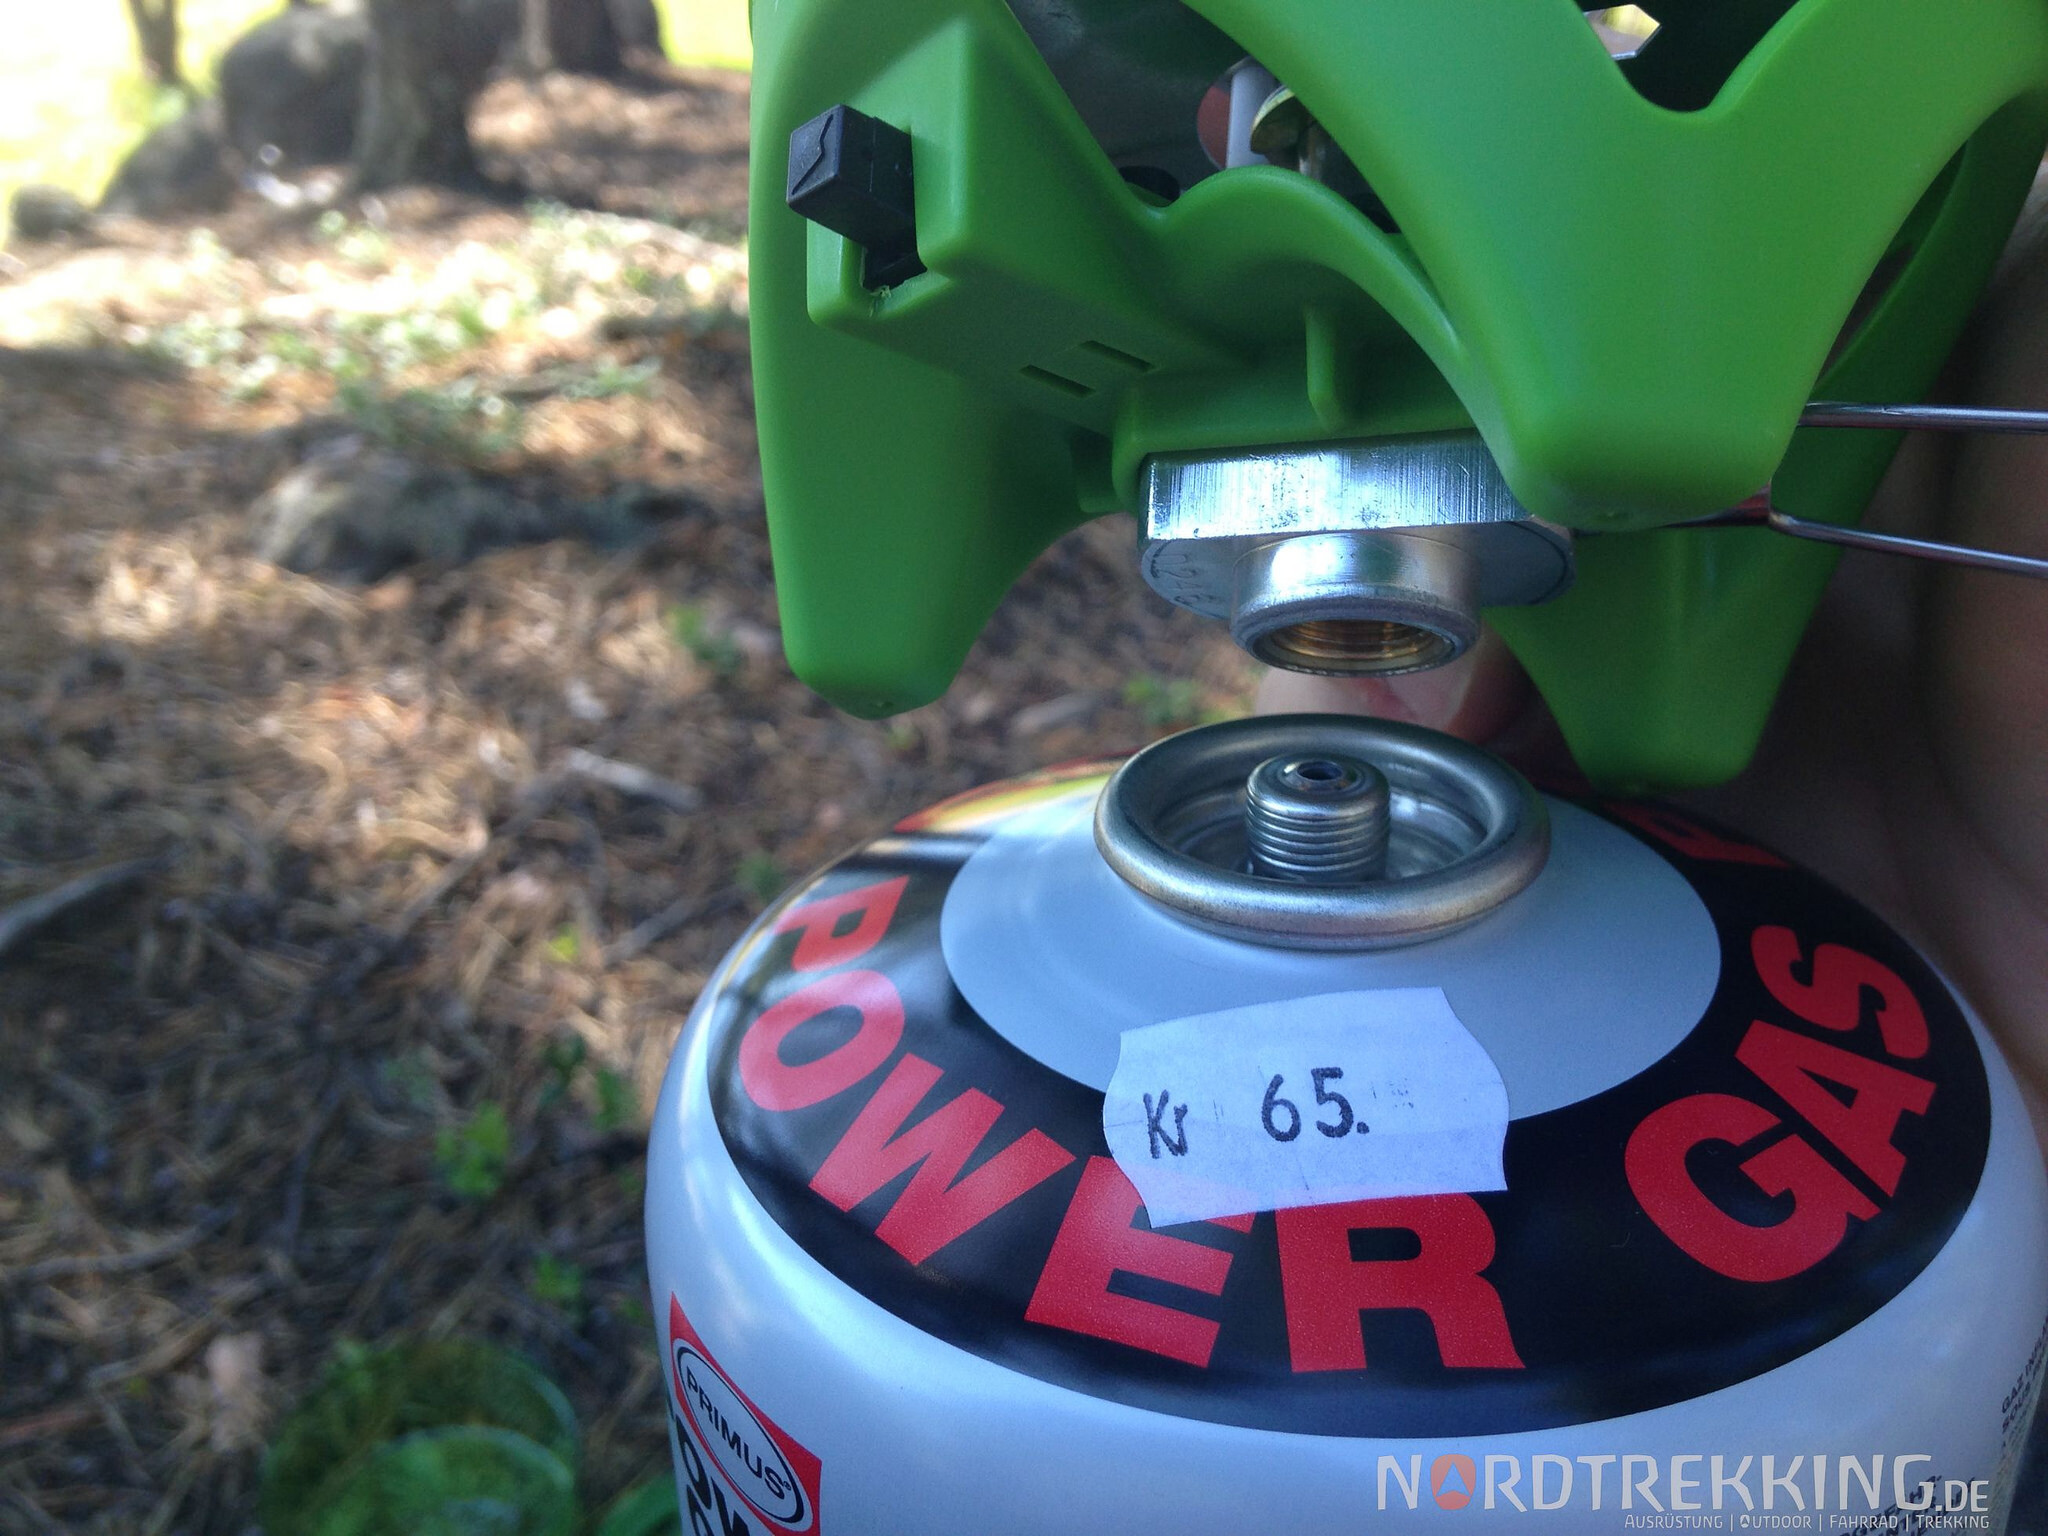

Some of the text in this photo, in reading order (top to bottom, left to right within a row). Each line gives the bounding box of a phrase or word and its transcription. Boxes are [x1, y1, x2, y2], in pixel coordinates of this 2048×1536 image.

[738, 876, 1938, 1374] POWER GAS
[1143, 1089, 1188, 1159] Kr
